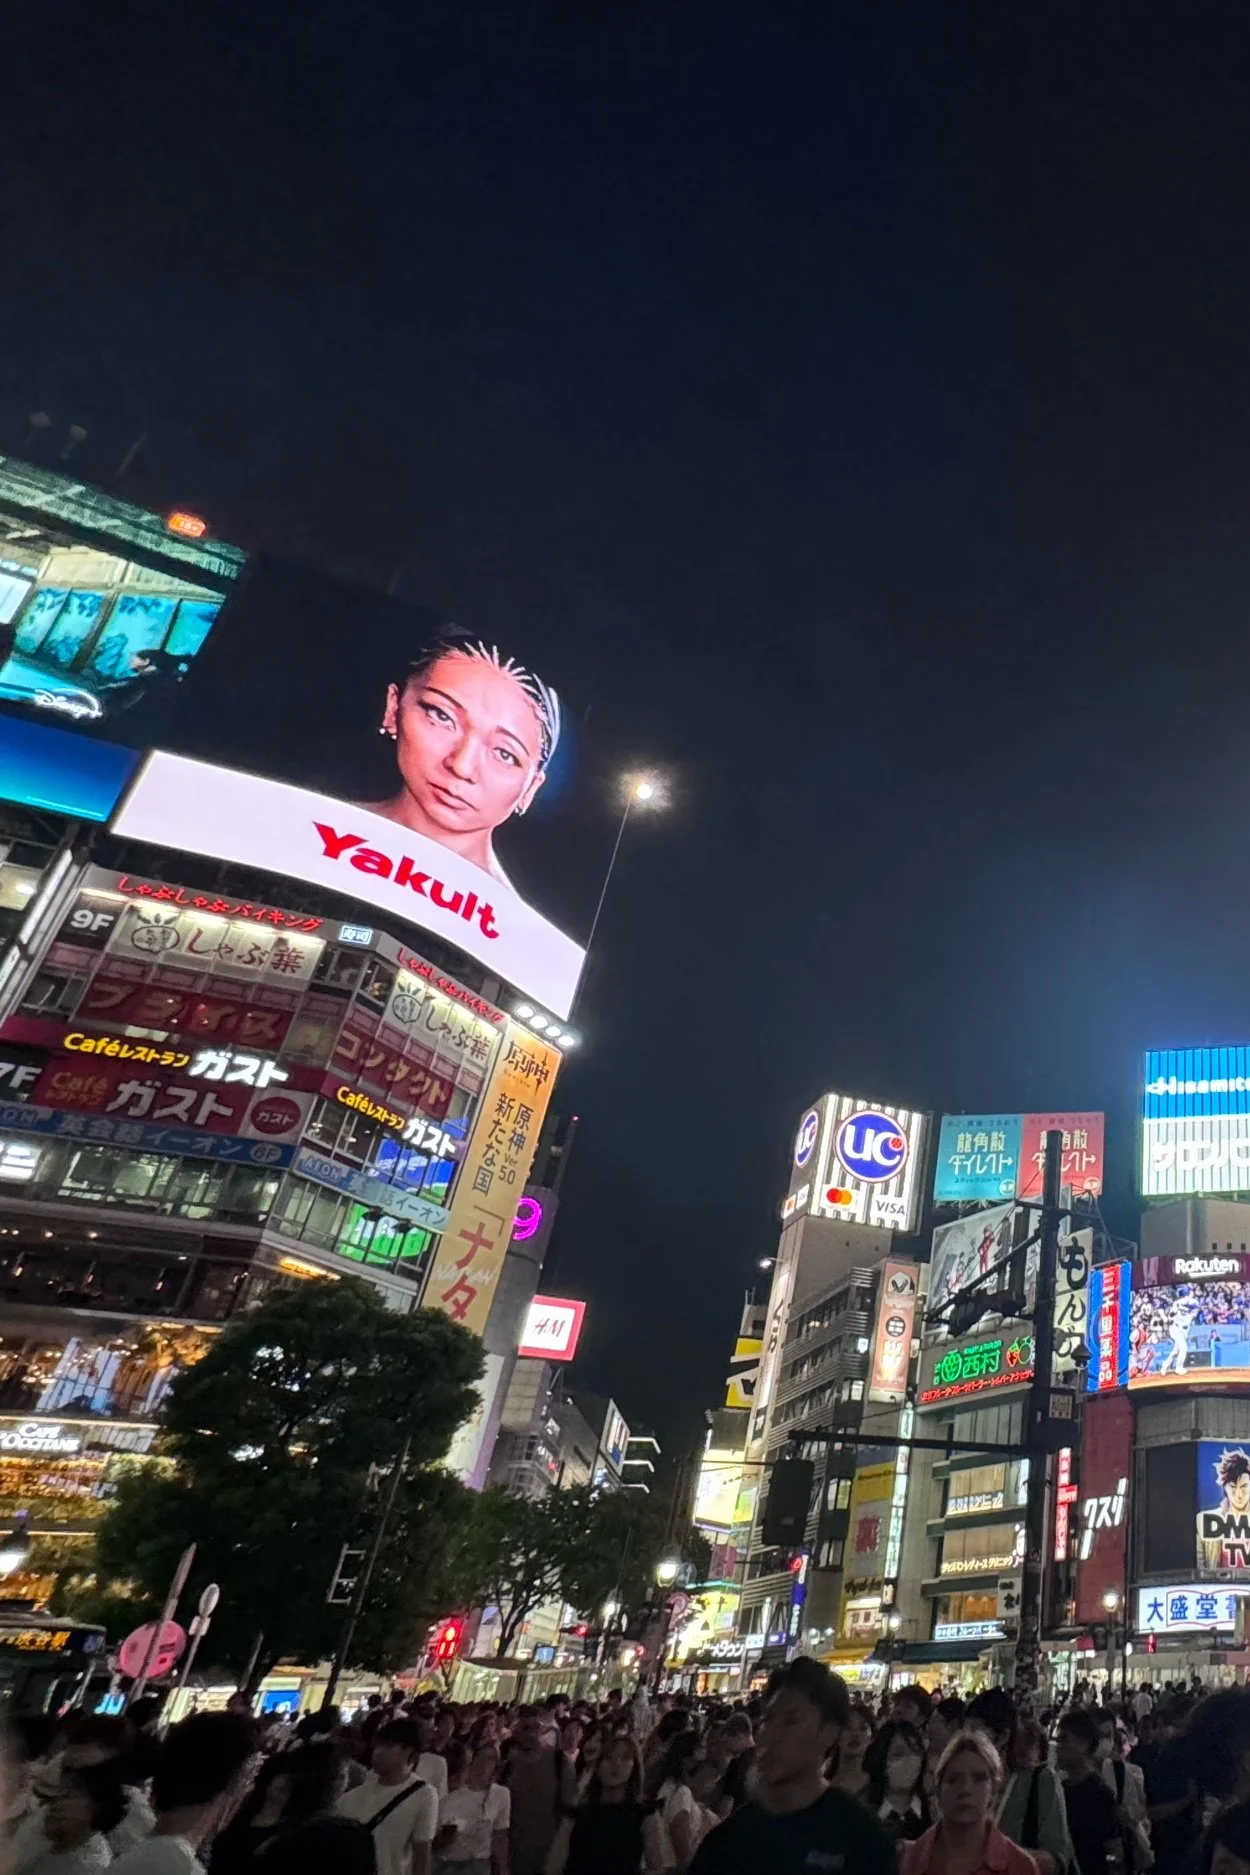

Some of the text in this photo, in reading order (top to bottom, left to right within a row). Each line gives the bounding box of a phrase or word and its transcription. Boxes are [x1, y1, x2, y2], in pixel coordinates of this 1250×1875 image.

[313, 821, 499, 938] Yakult
[70, 909, 114, 931] 9F
[188, 928, 304, 973] しゃぶ葉
[425, 1003, 491, 1061] しゃぶ葉
[188, 1047, 289, 1088] ガスト
[105, 1079, 234, 1125] ガスト
[402, 1117, 456, 1158] ガスト
[472, 1092, 516, 1197] 新たな国
[508, 1103, 533, 1155] 原神
[843, 1124, 902, 1167] UC
[957, 1131, 1006, 1153] 龍角散
[877, 1200, 906, 1216] VISA
[1174, 1257, 1240, 1275] Rakuten
